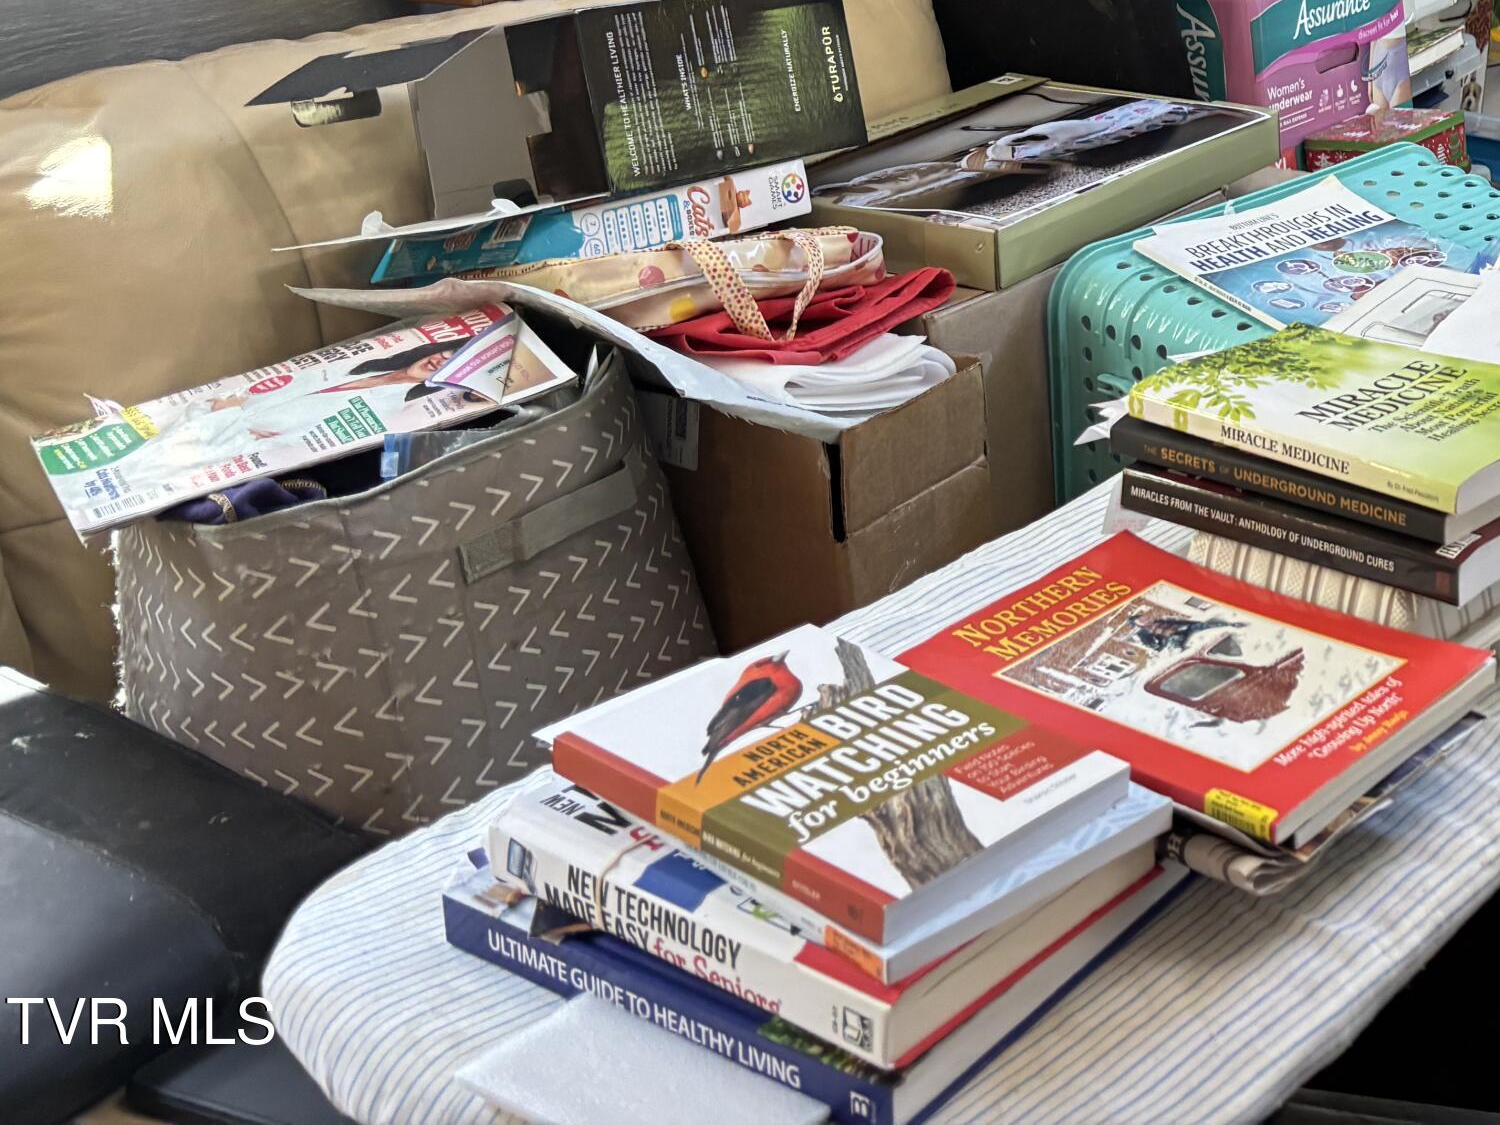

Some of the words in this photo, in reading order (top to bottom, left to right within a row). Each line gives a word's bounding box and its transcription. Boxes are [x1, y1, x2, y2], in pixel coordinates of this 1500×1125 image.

[1390, 10, 1400, 23] her
[606, 31, 619, 66] LIVING
[612, 65, 629, 117] HEALTHIER
[1266, 76, 1307, 101] Women's
[1268, 89, 1314, 112] underwear
[622, 117, 632, 131] TO
[624, 131, 641, 177] WELCOME
[686, 185, 715, 237] Cats
[1184, 210, 1328, 259] BREAKTHROUGHS
[1324, 203, 1354, 217] IN
[1189, 246, 1271, 273] HEALTH
[1266, 229, 1308, 254] AND
[1302, 210, 1386, 242] HEALING
[1296, 359, 1441, 425] MIRACLE
[1328, 365, 1469, 433] MEDICINE
[1366, 419, 1394, 435] The
[1389, 395, 1452, 429] Scientific
[1446, 377, 1482, 401] Truth
[1398, 410, 1437, 435] About
[1435, 387, 1487, 417] Nature's
[1413, 418, 1446, 438] Most
[1443, 391, 1500, 423] Powerful
[1220, 425, 1279, 453] MIRACLE
[1281, 444, 1351, 475] MEDICINE
[1426, 417, 1481, 443] Healing
[1160, 447, 1217, 474] SECRETS
[1233, 466, 1337, 507] UNDERGROUND
[1339, 496, 1408, 527] MEDICINE
[1130, 485, 1169, 507] MIRACLES
[1170, 496, 1192, 513] FROM
[1193, 503, 1210, 518] THE
[1210, 508, 1239, 525] VAULT:
[1238, 517, 1288, 541] ANTHOLOGY
[1288, 531, 1301, 543] OF
[1300, 534, 1366, 564] UNDERGROUND
[1366, 555, 1396, 573] CURES
[951, 566, 1104, 648] NORTHERN
[982, 581, 1133, 662] MEMORIES
[809, 684, 926, 741] BIRD
[1273, 744, 1307, 767] More
[1385, 675, 1403, 689] of
[1352, 713, 1377, 729] Up
[732, 739, 828, 789] AMERICAN
[739, 702, 970, 819] WATCHING
[742, 729, 811, 764] NORTH
[539, 794, 586, 818] NEW
[787, 798, 839, 843] for
[838, 721, 997, 804] beginners
[543, 882, 597, 924] MADE
[604, 915, 650, 952] EASY
[652, 936, 688, 968] for
[568, 864, 610, 909] NEW
[614, 885, 742, 970] TECHNOLOGY
[487, 928, 569, 983] ULTIMATE
[570, 967, 625, 1011] GUIDE
[625, 993, 652, 1019] TO
[652, 1003, 735, 1058] HEALTHY
[737, 1040, 801, 1089] LIVING
